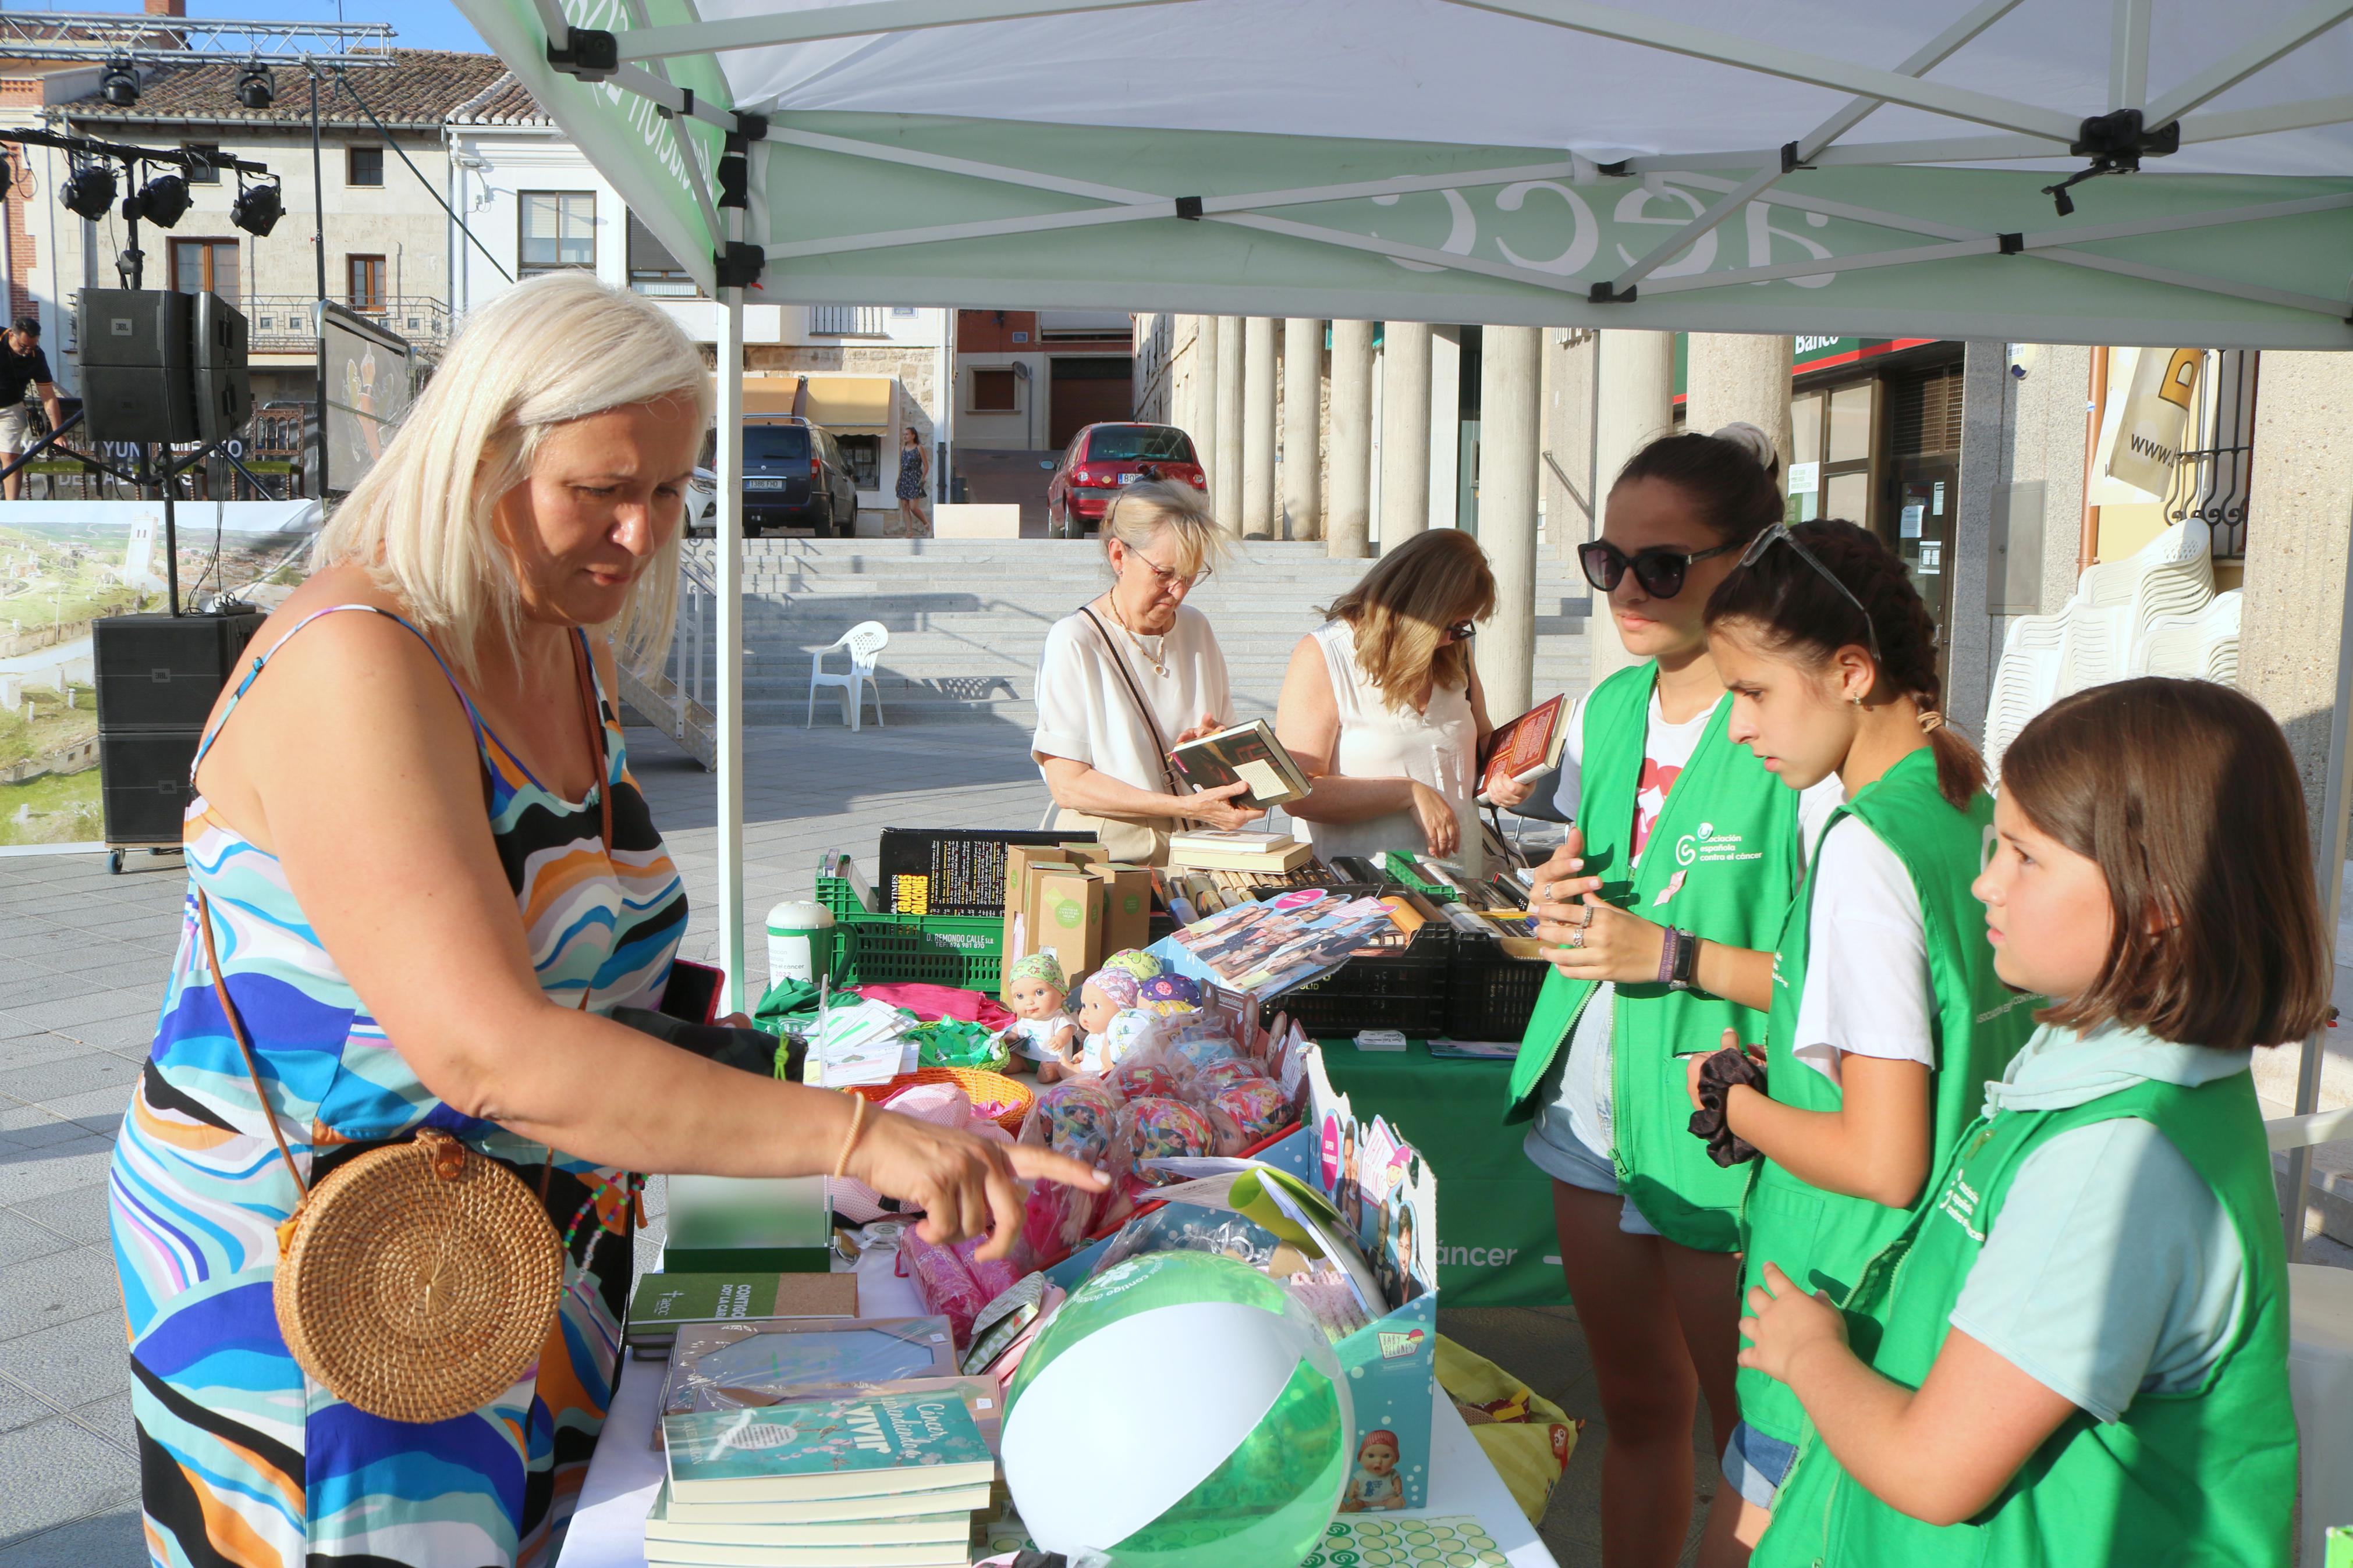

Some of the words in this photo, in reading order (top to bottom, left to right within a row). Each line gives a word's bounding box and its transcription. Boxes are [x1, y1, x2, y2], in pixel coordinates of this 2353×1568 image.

[115, 323, 129, 331] JBL
[1701, 834, 1742, 843] ociación
[1699, 844, 1736, 853] española
[897, 874, 911, 912] GRANDES
[911, 876, 928, 915] ORACIONES
[927, 933, 932, 941] D.
[935, 933, 965, 943] REMONDO
[966, 934, 985, 943] CALLE
[1436, 1240, 1518, 1267] áncer
[721, 1284, 733, 1296] DOY
[1106, 1275, 1149, 1296] contigo
[658, 1298, 672, 1316] aecc
[718, 1296, 730, 1305] LA
[731, 1284, 751, 1318] CONTIGO
[715, 1305, 728, 1318] CAR
[1383, 1335, 1401, 1346] BABY
[1385, 1343, 1414, 1356] PELONES
[916, 1403, 949, 1441] Cáncer,
